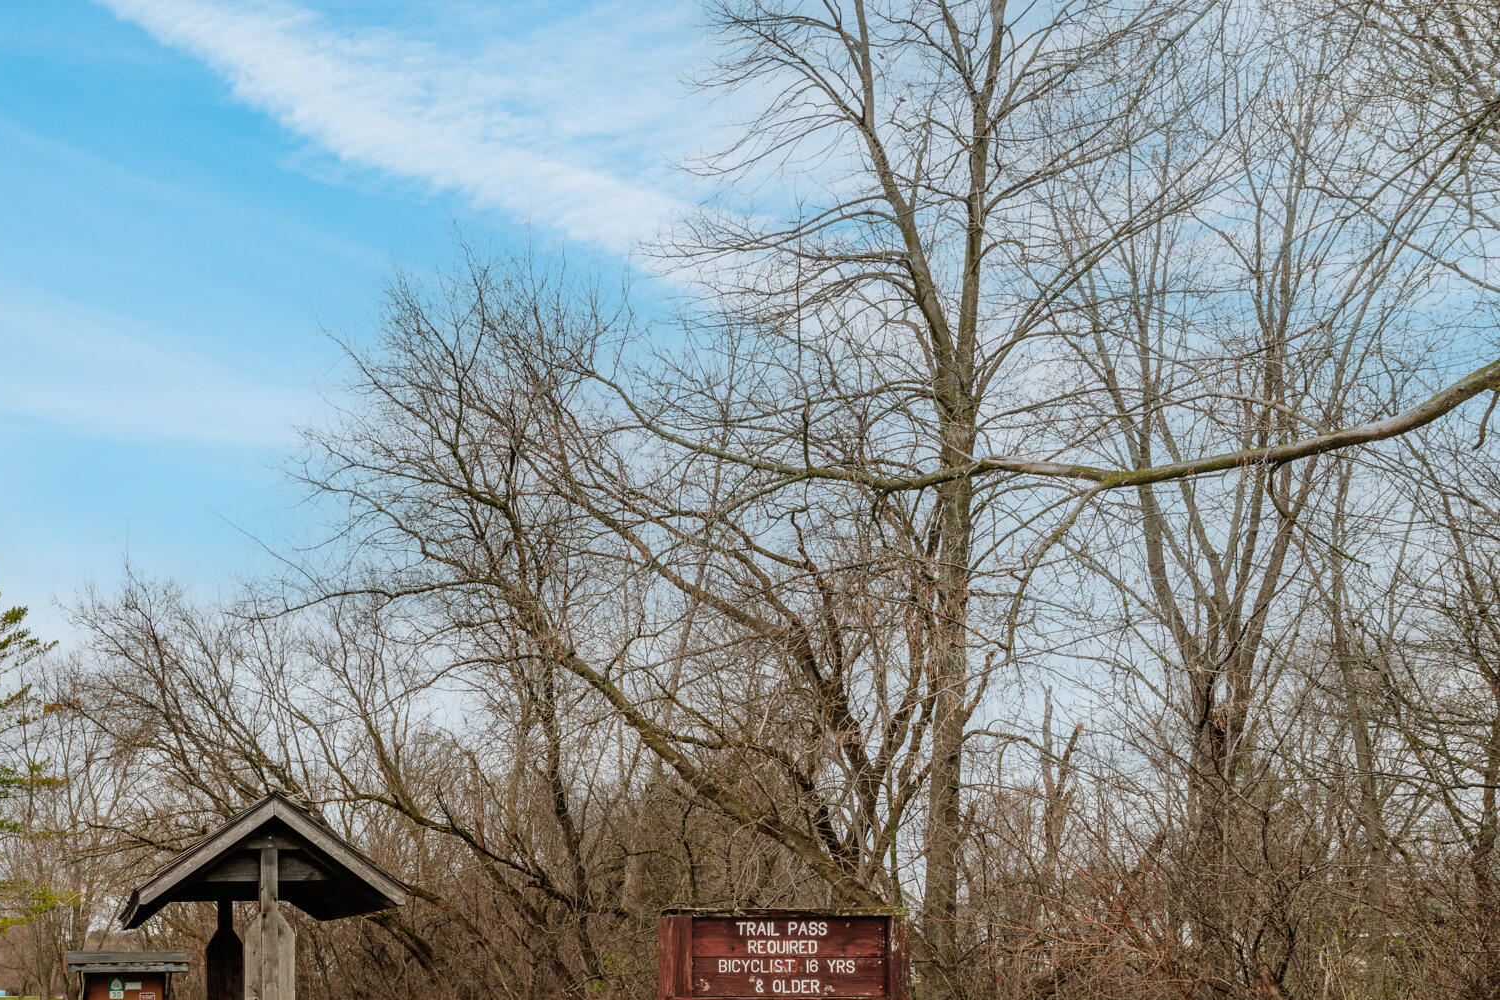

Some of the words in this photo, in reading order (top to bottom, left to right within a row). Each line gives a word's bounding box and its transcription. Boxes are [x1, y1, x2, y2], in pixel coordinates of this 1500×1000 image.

[736, 922, 780, 936] TRAIL
[788, 922, 828, 936] PASS
[747, 940, 818, 954] REQUIRED
[718, 959, 796, 973] BICYCLIST
[806, 959, 819, 973] 16
[827, 959, 856, 973] YRS
[755, 979, 765, 993] &
[772, 980, 821, 993] OLDER
